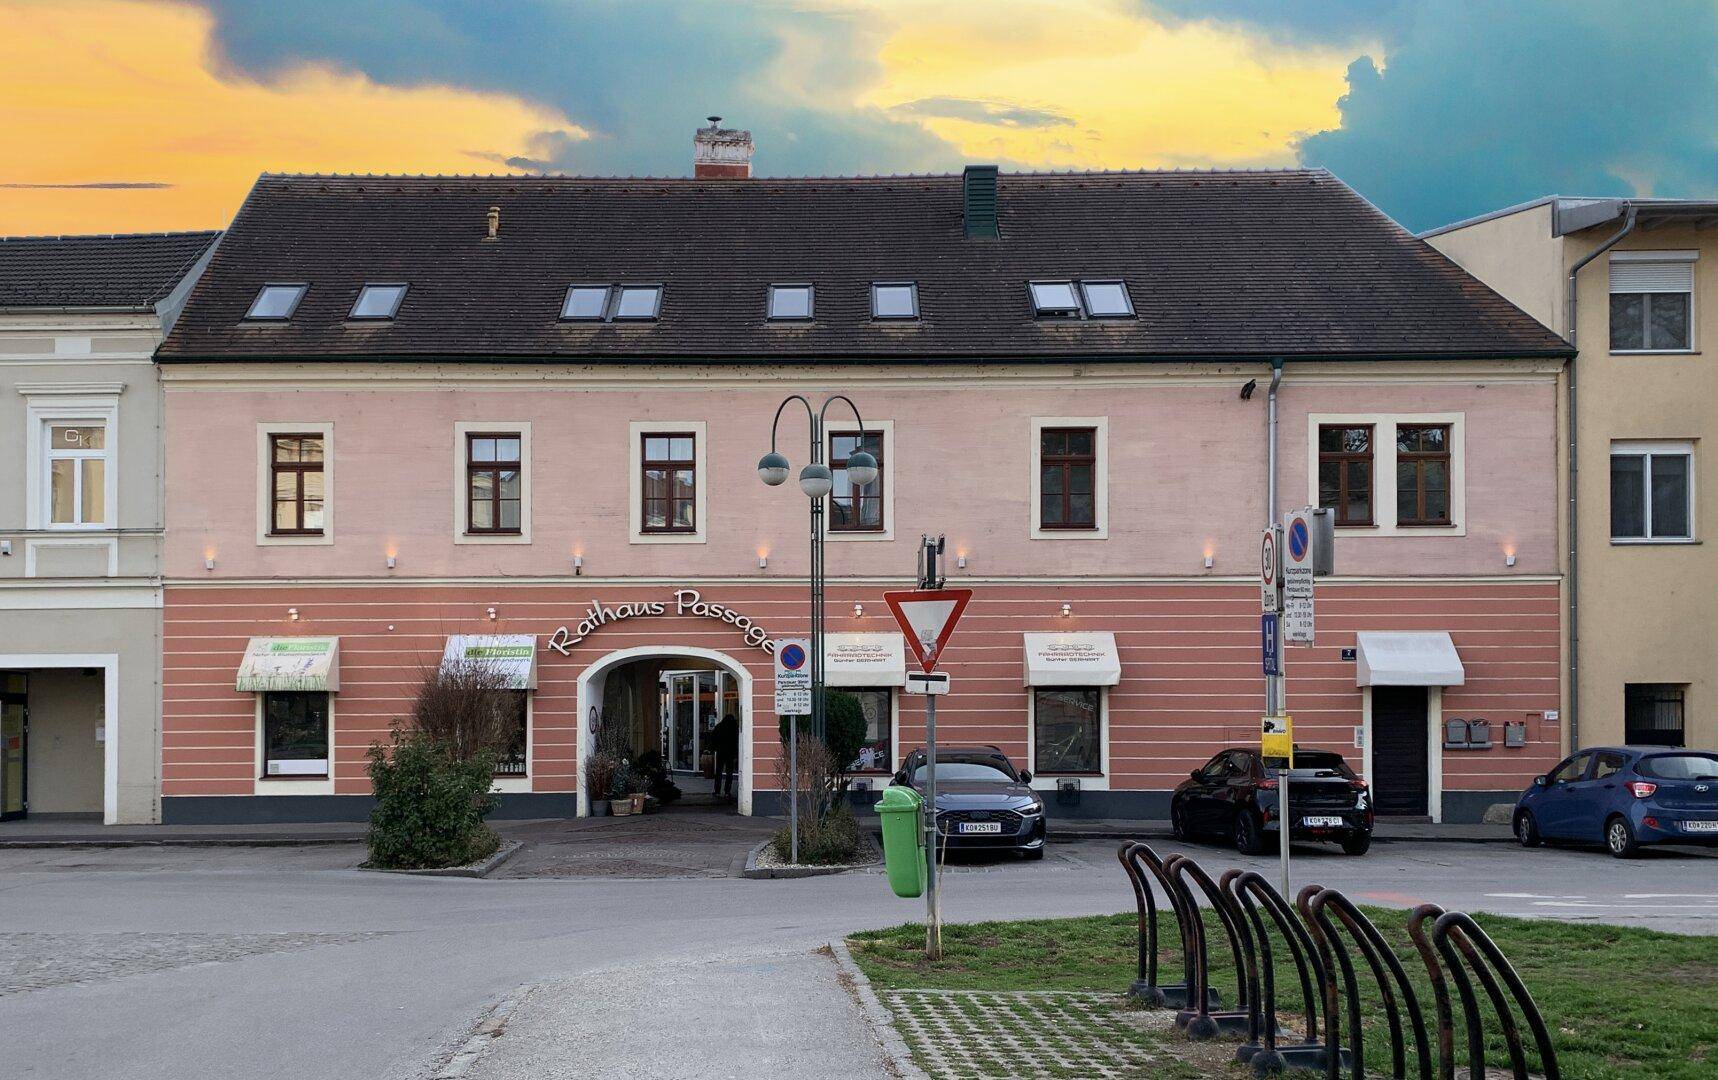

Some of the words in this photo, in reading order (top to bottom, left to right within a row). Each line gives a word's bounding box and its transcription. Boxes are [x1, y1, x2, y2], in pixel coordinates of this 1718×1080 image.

[1265, 547, 1272, 570] 30
[1285, 567, 1312, 575] Kurzparkzone
[1264, 590, 1274, 607] Zone
[547, 599, 665, 657] Rathaus
[673, 589, 775, 656] Passage
[1265, 621, 1274, 653] H
[467, 647, 483, 656] die
[485, 647, 529, 656] Floristin
[1058, 695, 1095, 712] SERVICE
